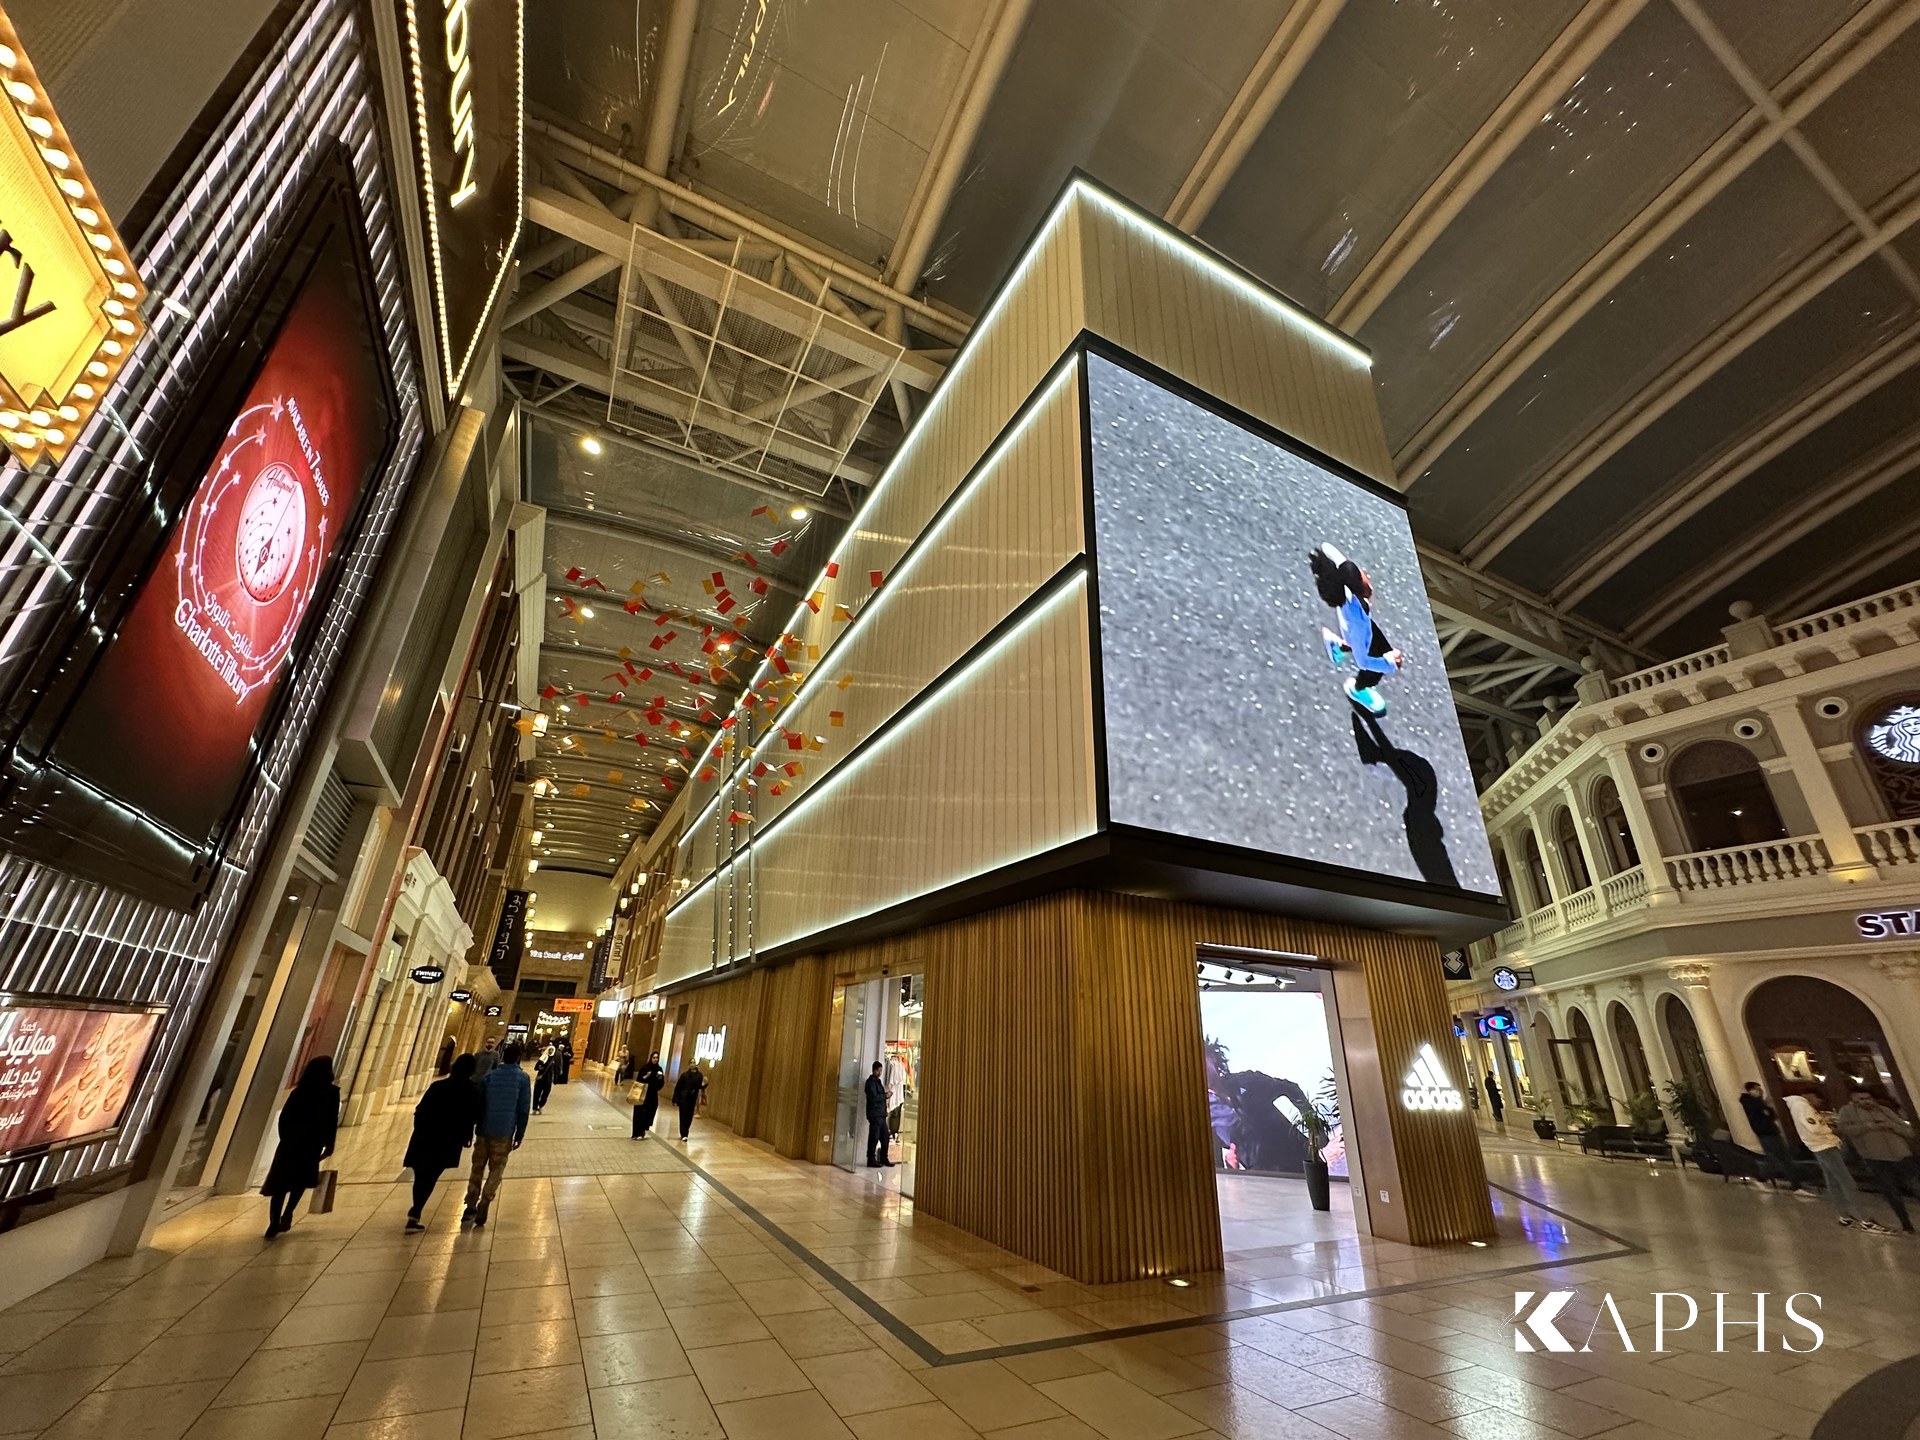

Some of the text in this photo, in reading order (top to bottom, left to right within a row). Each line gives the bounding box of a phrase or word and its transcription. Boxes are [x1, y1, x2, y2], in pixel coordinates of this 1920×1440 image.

[310, 449, 321, 470] 7
[174, 598, 251, 705] Charlotte Tilbury
[1856, 909, 1920, 938] ST
[583, 1002, 593, 1010] 15
[1402, 1085, 1464, 1111] adidas
